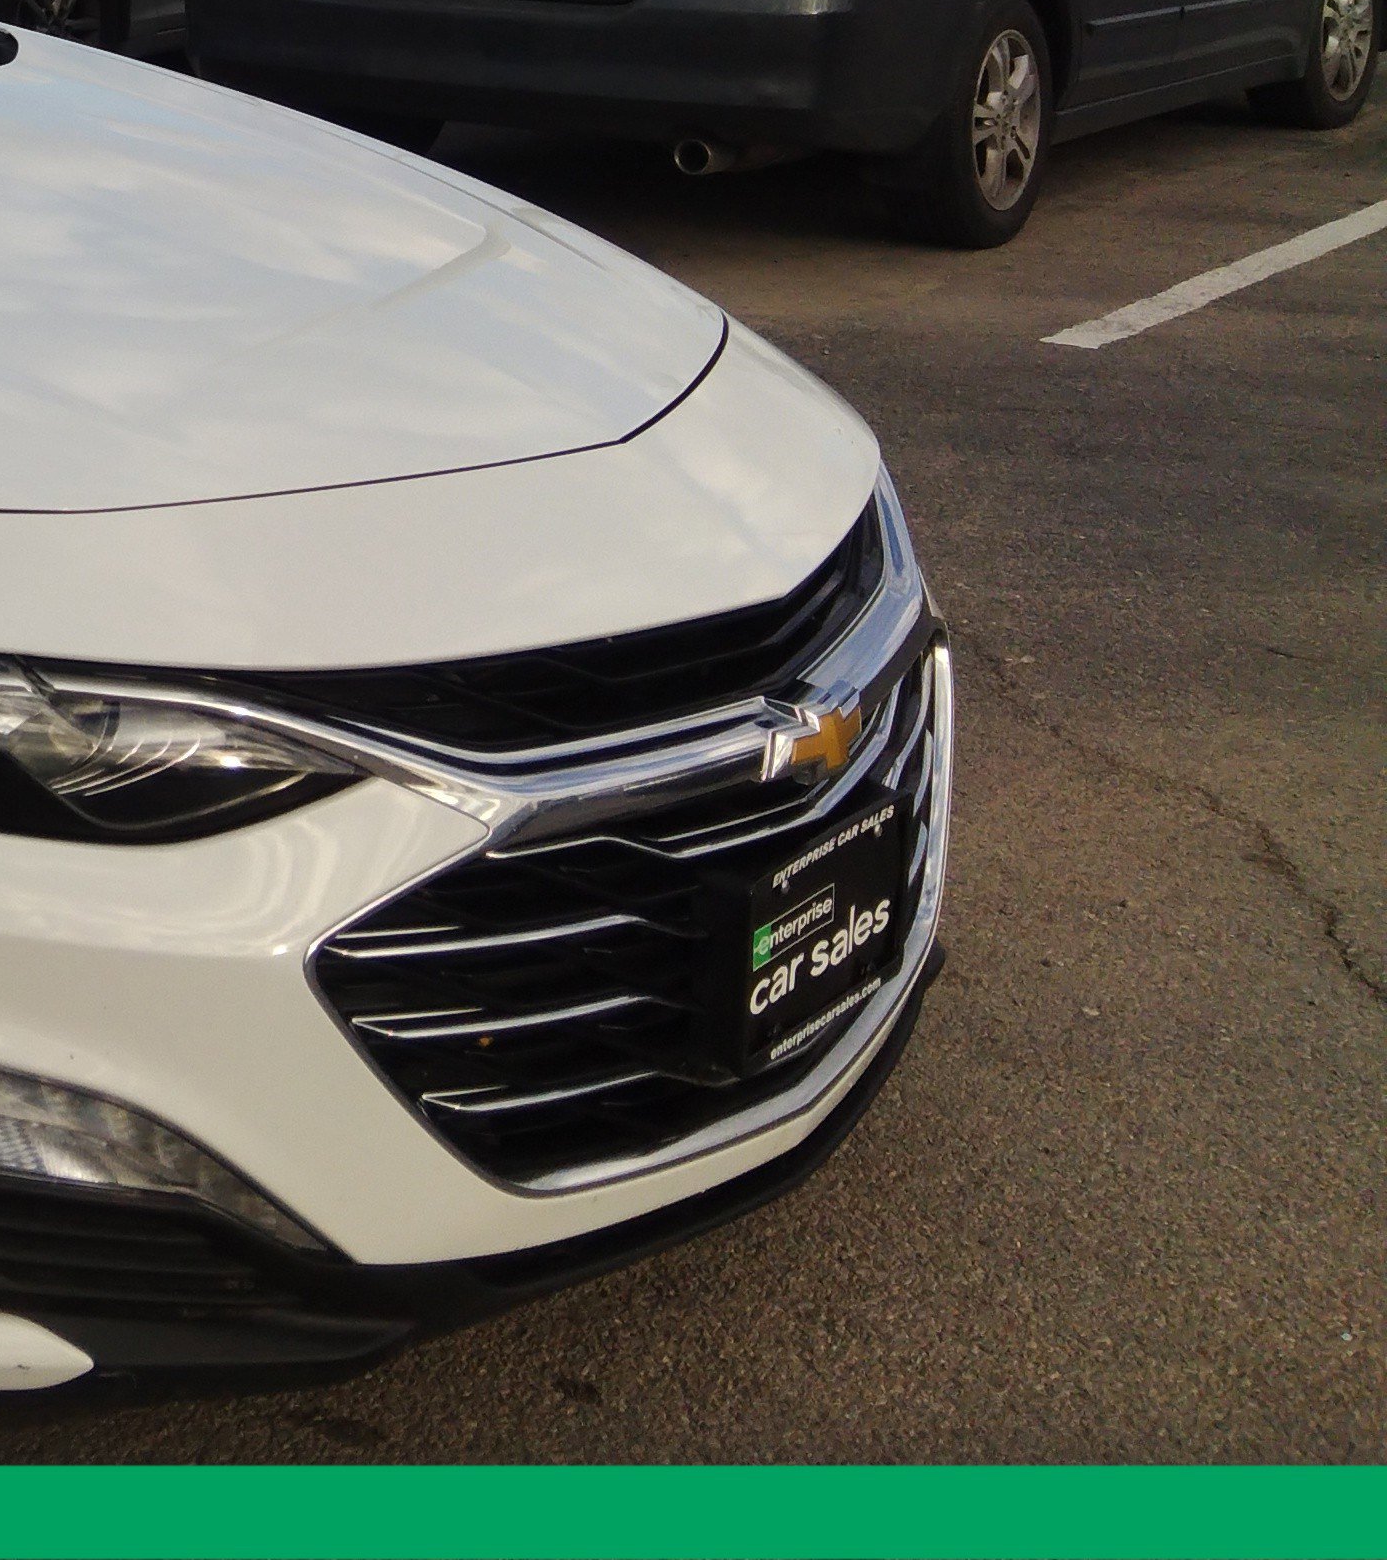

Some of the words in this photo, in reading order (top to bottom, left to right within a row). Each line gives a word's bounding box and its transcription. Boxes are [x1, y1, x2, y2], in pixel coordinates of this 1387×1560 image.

[772, 836, 838, 889] ENTERPRISE
[837, 823, 860, 847] CAR
[860, 804, 896, 834] SALES
[749, 951, 806, 1016] car
[809, 898, 892, 979] sales
[755, 896, 835, 956] enterprise
[769, 976, 882, 1061] enterprisecarsales.com
